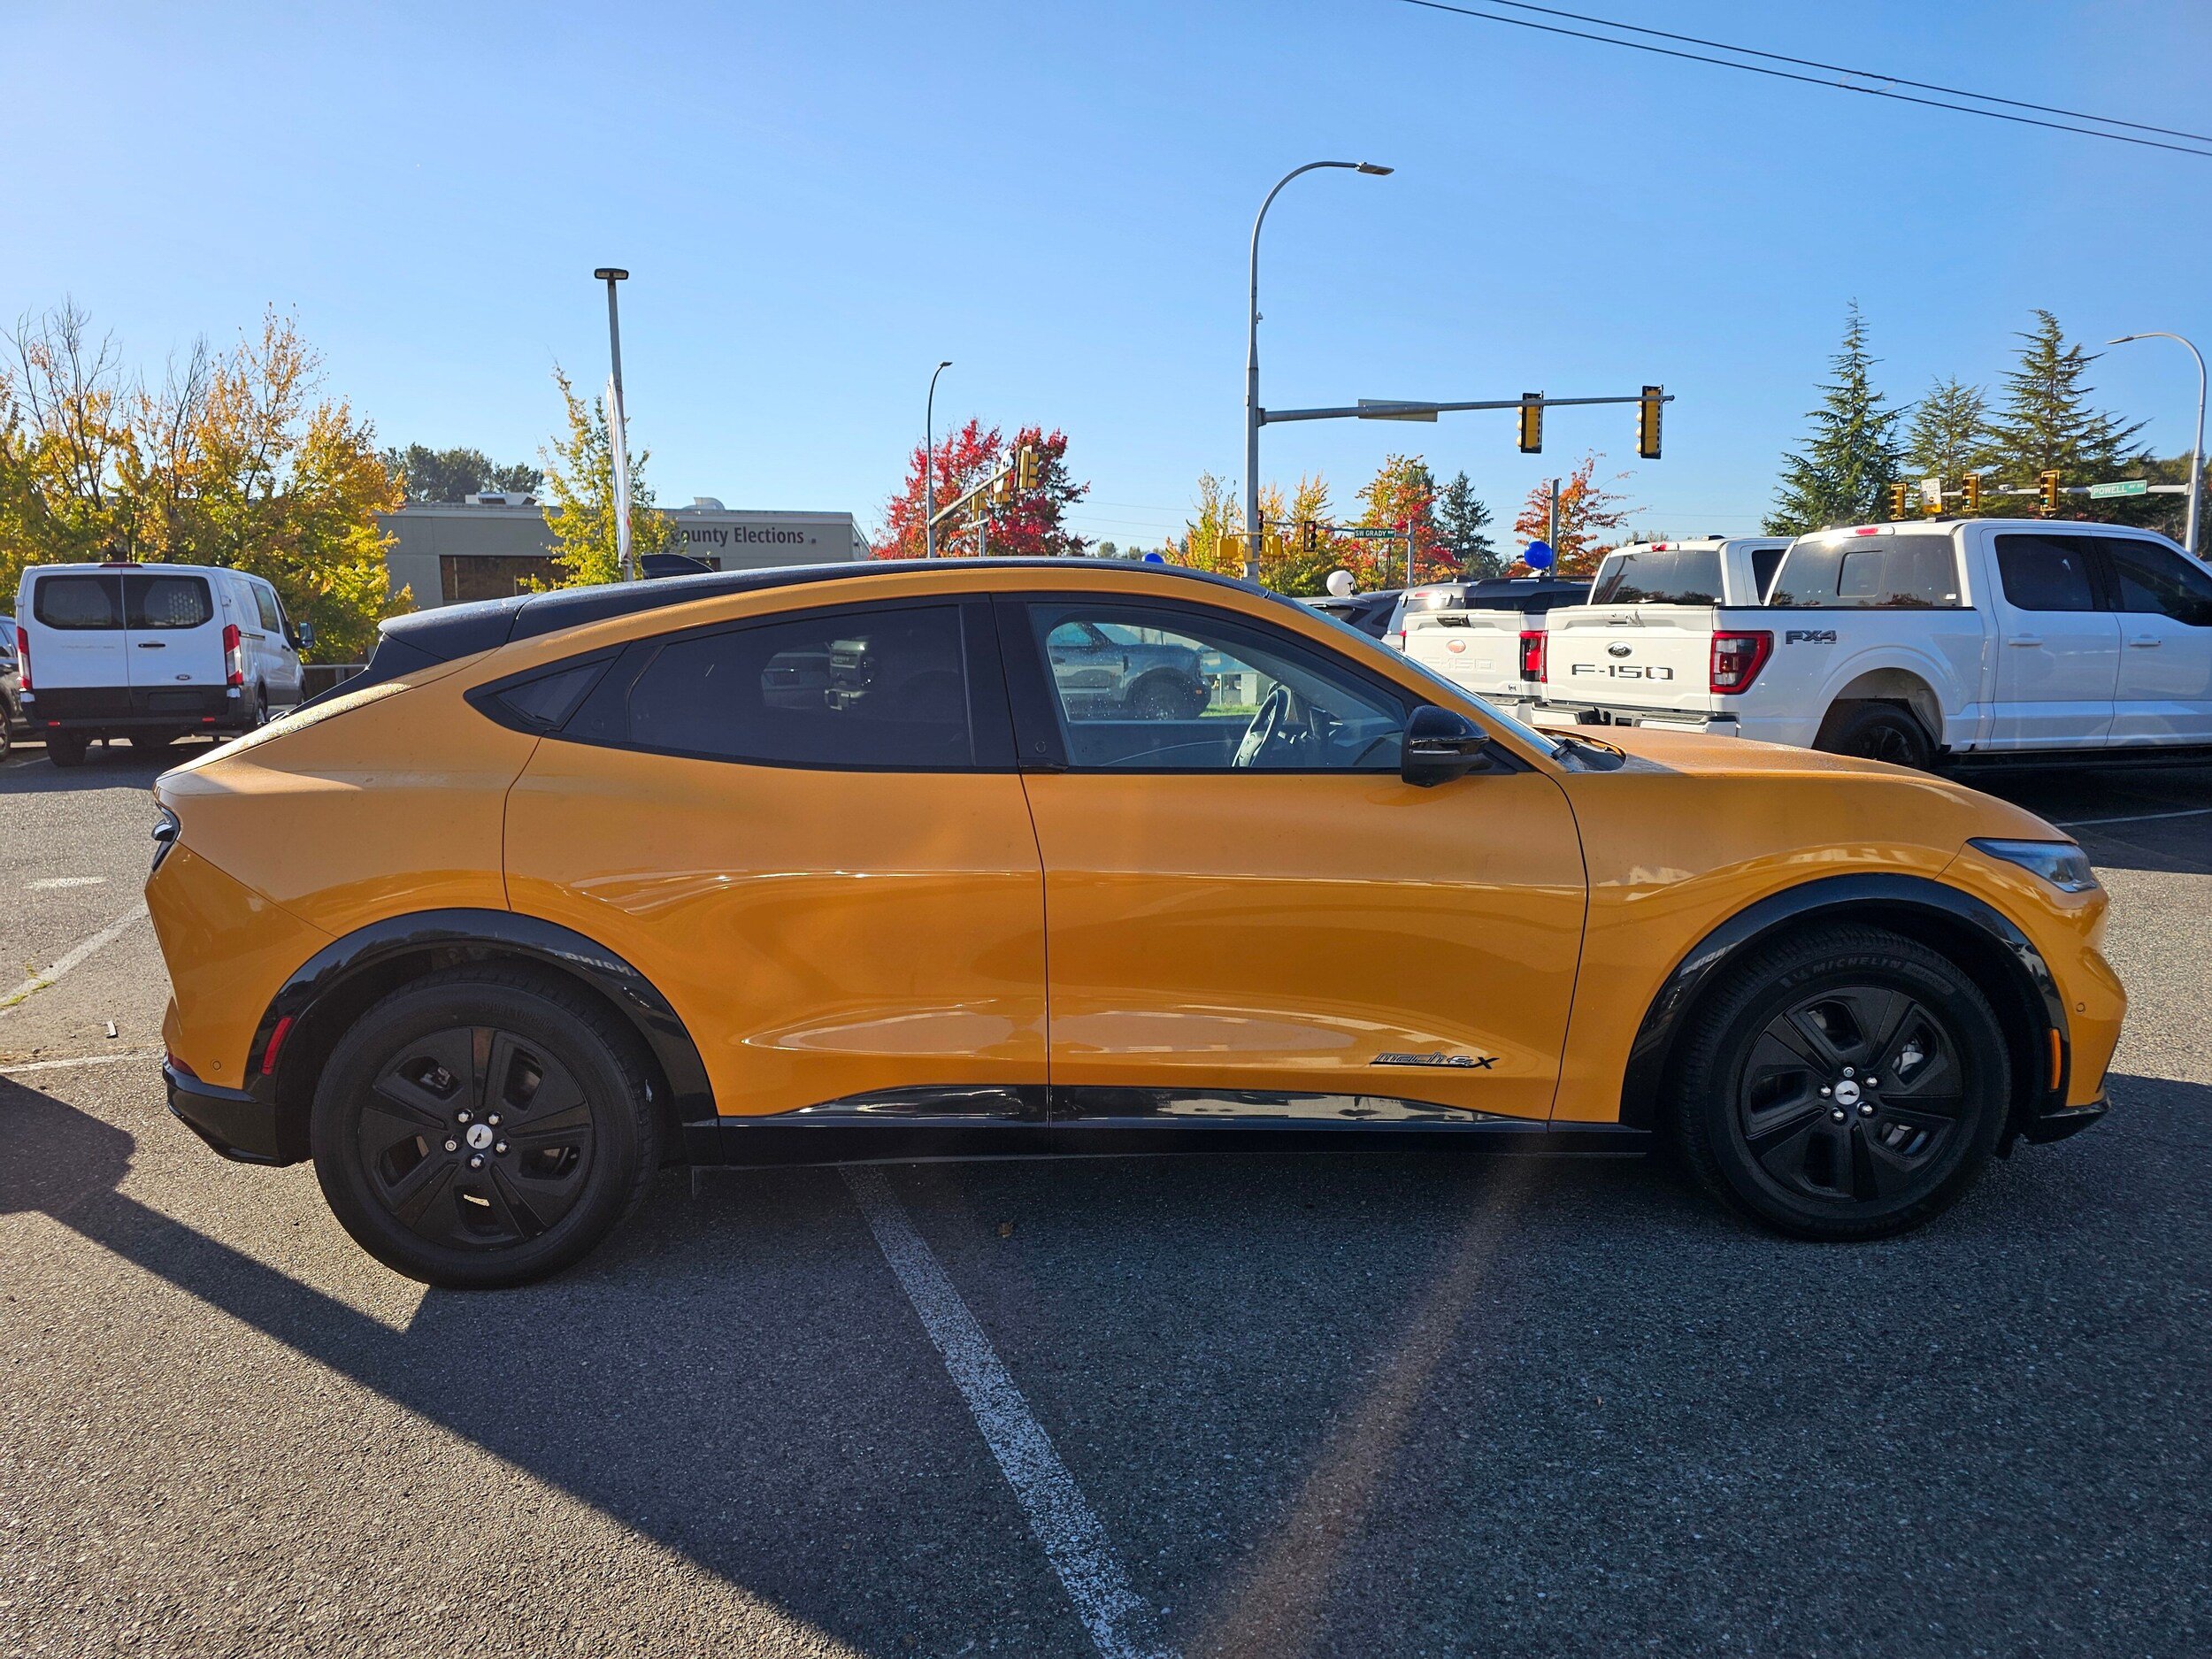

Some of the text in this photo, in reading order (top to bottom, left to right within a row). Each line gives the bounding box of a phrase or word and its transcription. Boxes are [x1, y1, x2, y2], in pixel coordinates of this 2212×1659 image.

[2093, 485, 2127, 495] POWELL
[734, 526, 804, 543] Elections
[1786, 630, 1837, 644] FX4
[1571, 664, 1674, 680] F-150
[1812, 956, 1903, 974] MICHELIN
